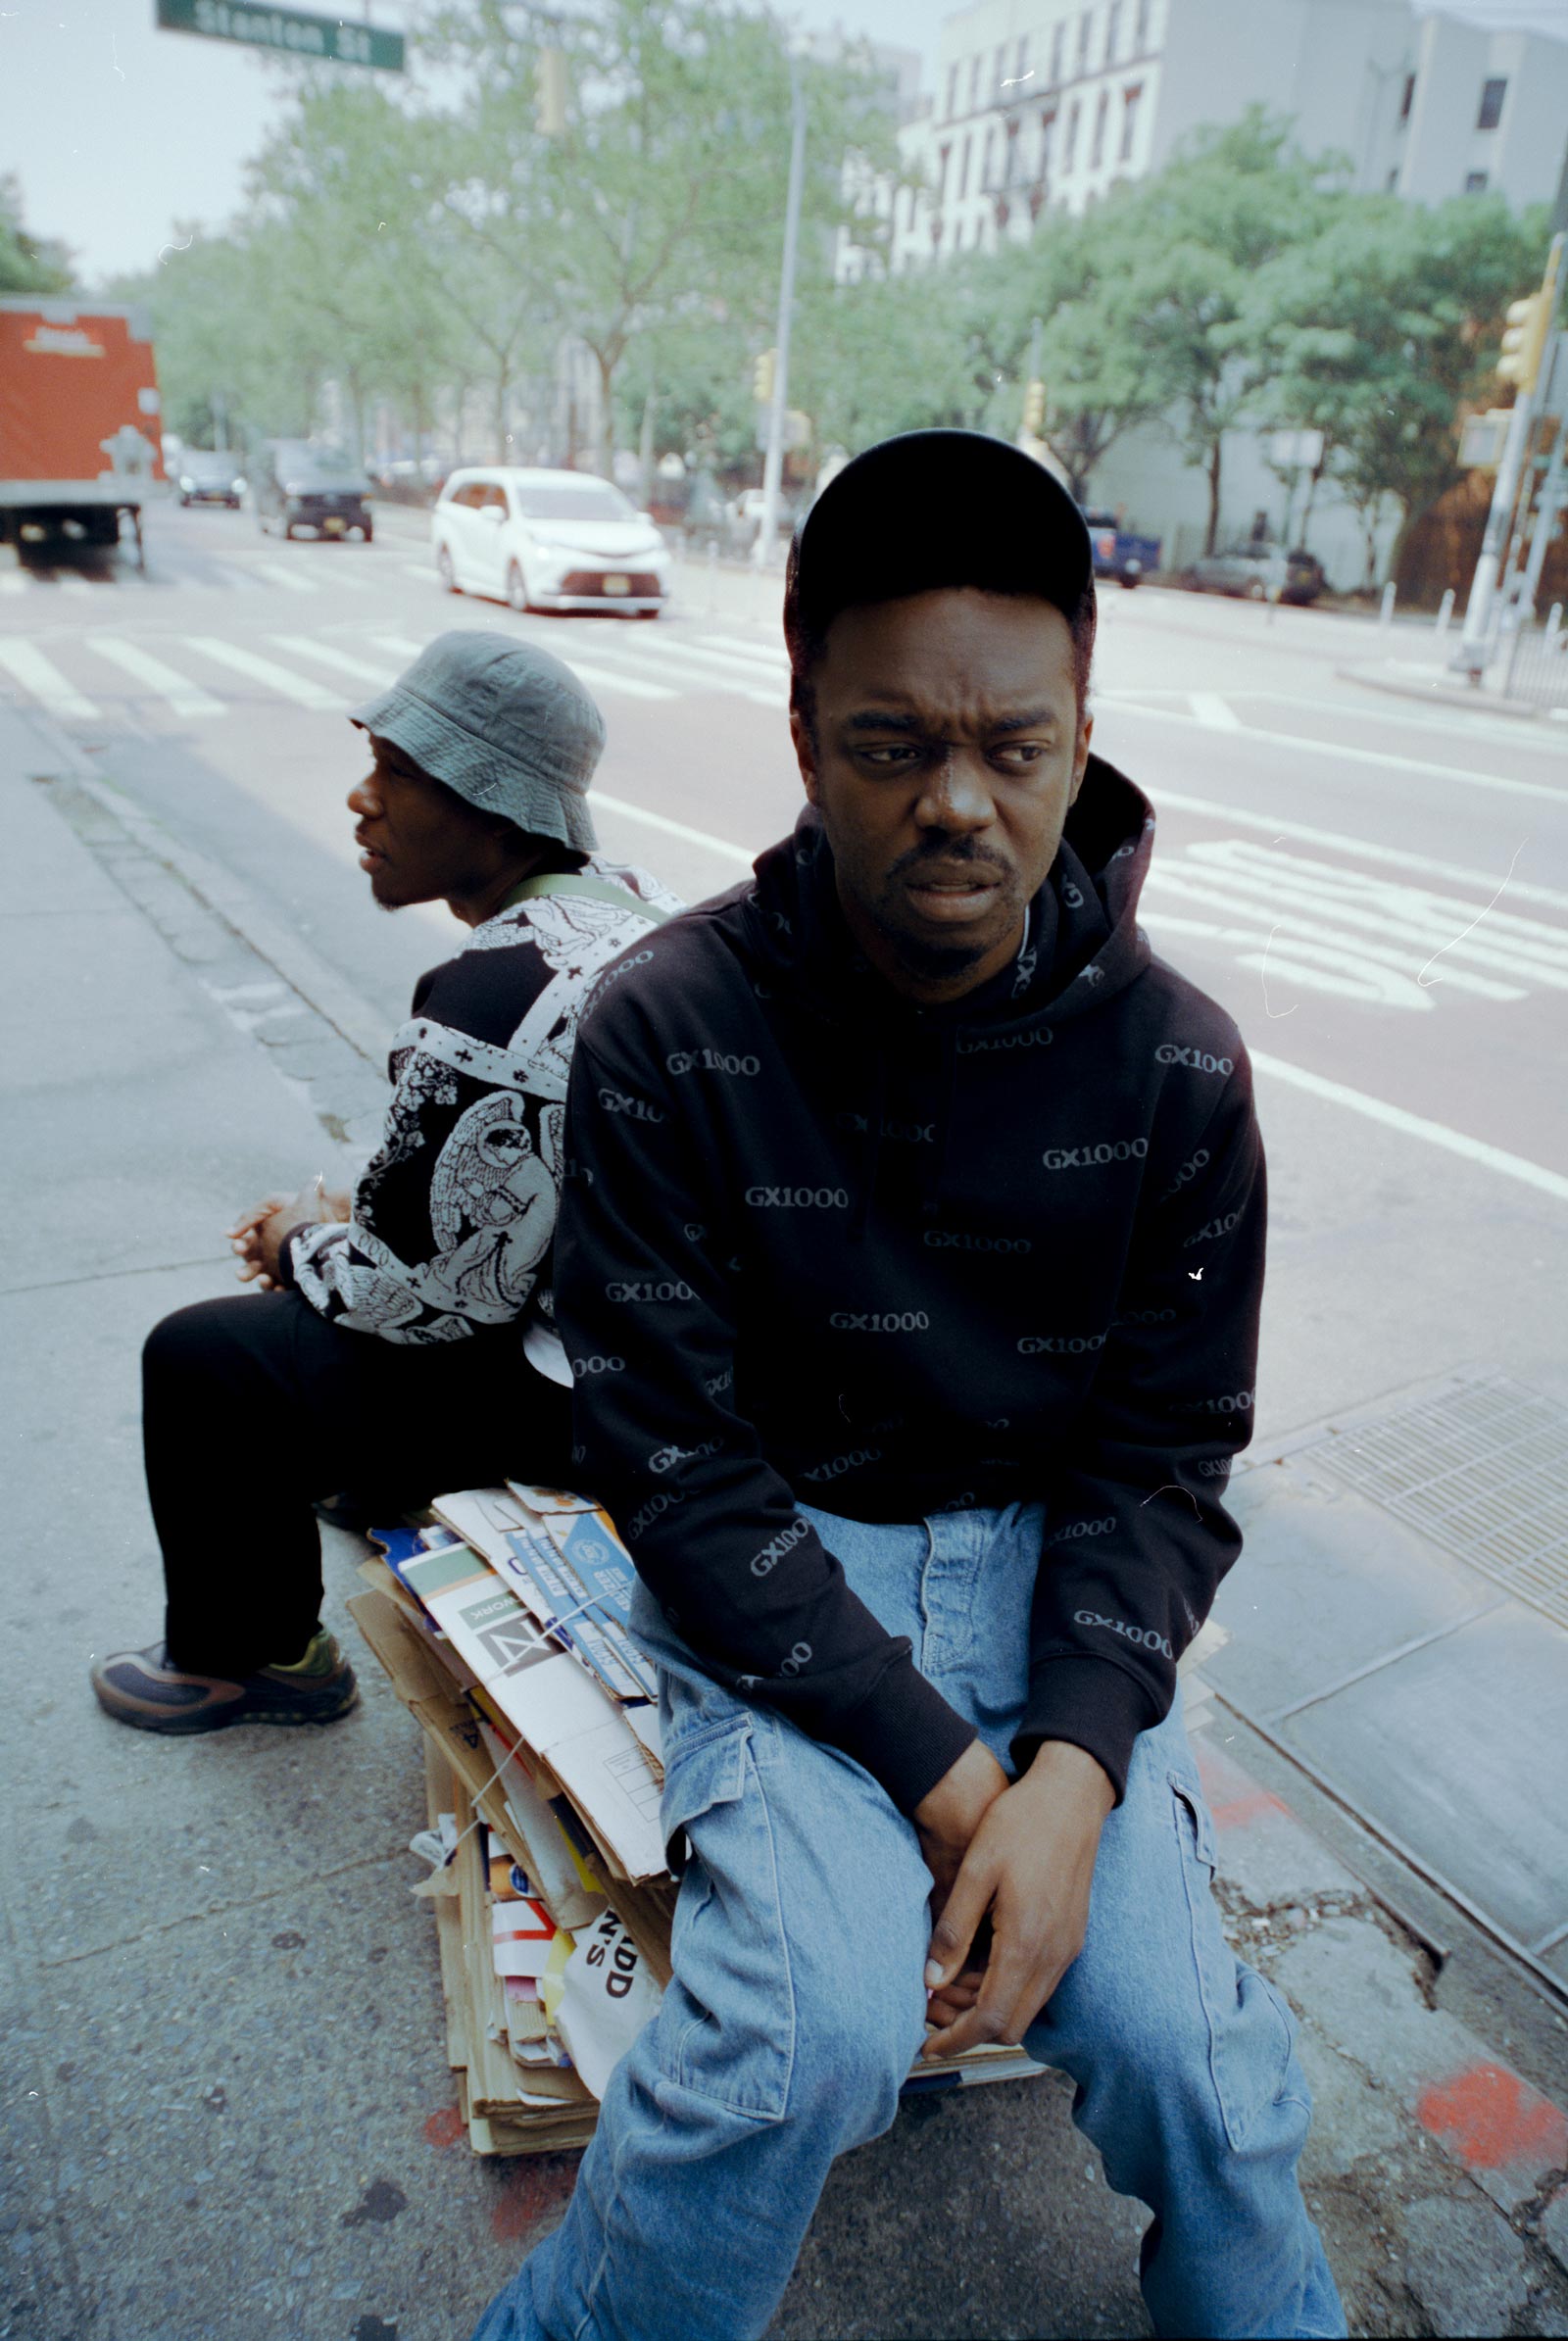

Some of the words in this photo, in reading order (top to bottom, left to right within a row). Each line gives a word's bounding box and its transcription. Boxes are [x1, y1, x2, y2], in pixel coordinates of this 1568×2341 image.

[1041, 1136, 1149, 1171] GX1000
[743, 1186, 851, 1210] GX1000
[922, 1228, 1034, 1255] GX1000
[829, 1310, 931, 1334] GX1000
